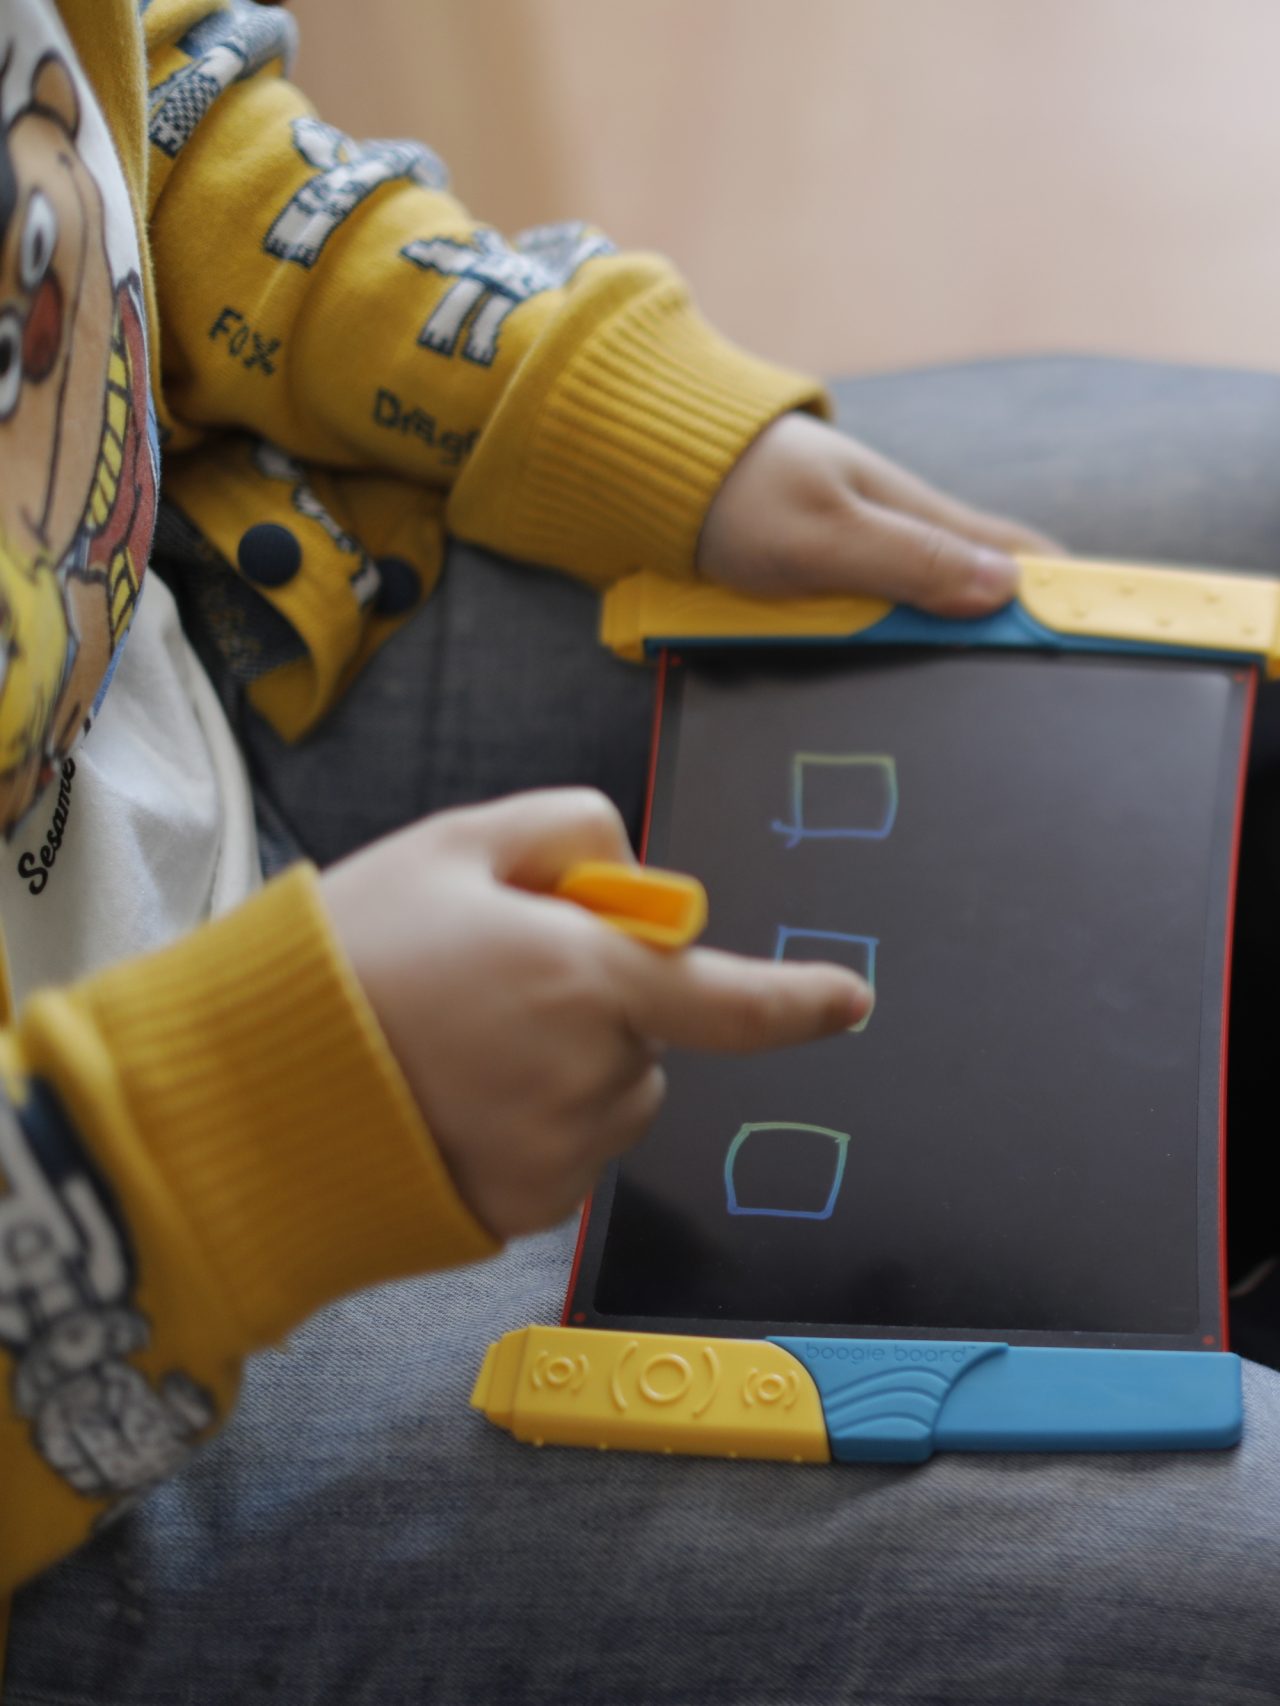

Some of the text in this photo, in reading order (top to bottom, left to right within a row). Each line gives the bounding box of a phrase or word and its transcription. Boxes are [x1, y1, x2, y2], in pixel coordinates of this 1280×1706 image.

[371, 386, 479, 466] Drag
[17, 757, 77, 895] Sesame
[805, 1342, 886, 1365] boogie
